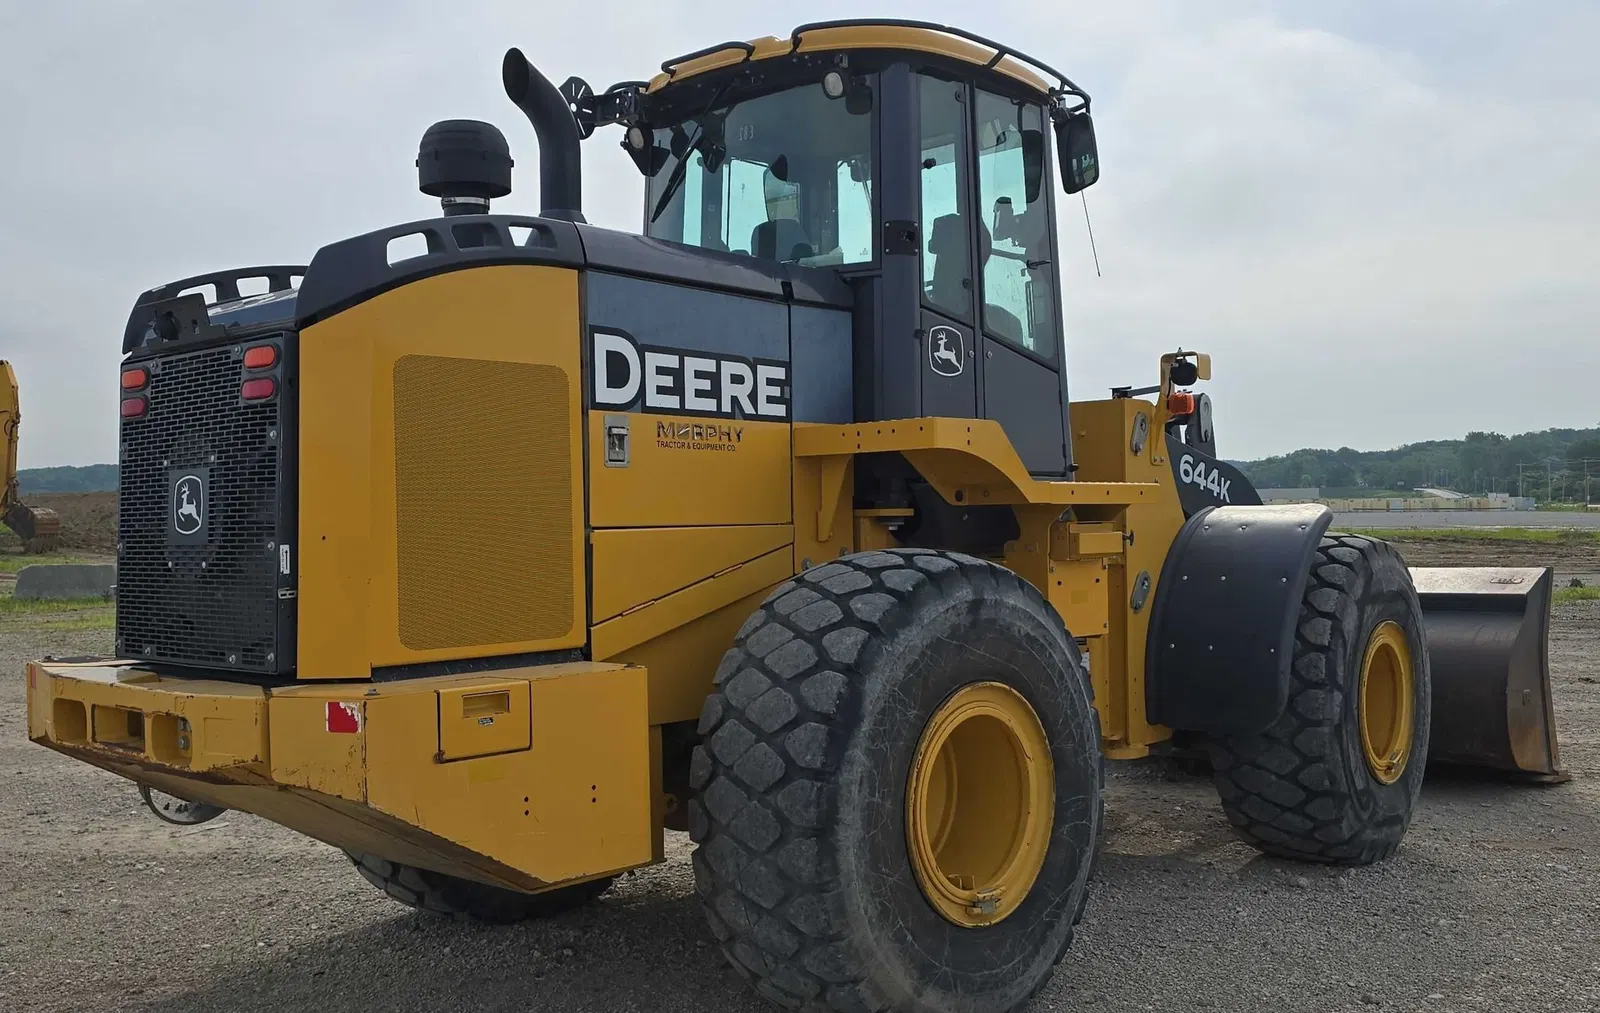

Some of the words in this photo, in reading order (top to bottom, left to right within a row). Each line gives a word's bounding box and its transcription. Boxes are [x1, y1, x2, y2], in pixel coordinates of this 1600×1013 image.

[593, 332, 788, 417] DEERE
[656, 420, 744, 443] MURPHY
[657, 440, 686, 450] TRACTOR
[687, 442, 691, 450] &
[692, 443, 726, 451] EQUIPMENT
[1179, 454, 1231, 504] 644K
